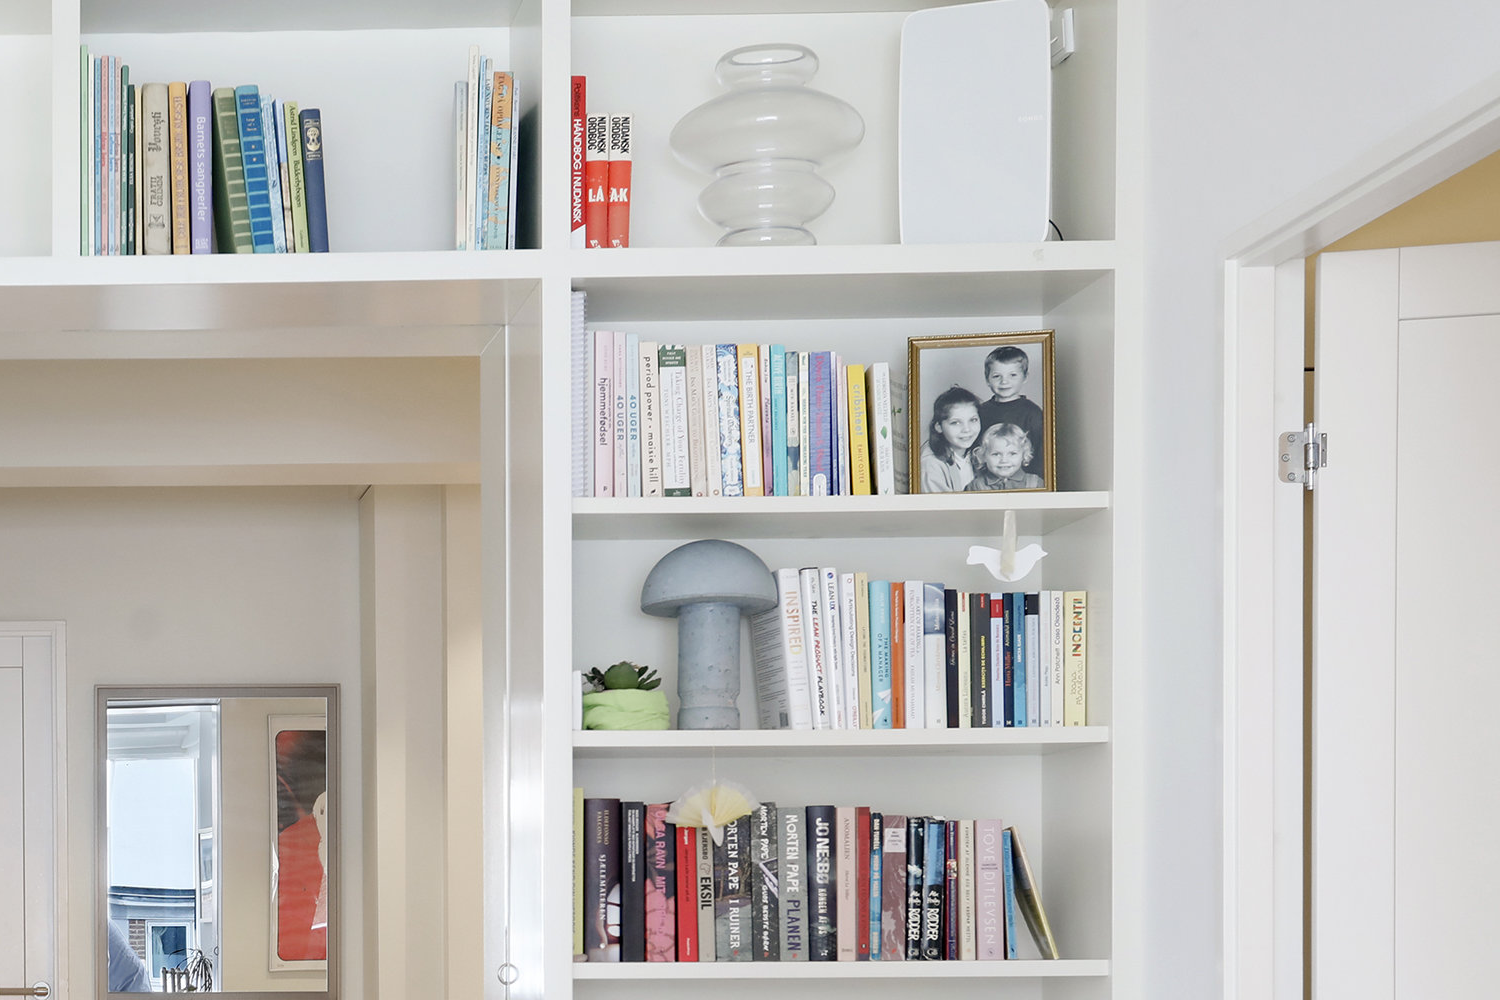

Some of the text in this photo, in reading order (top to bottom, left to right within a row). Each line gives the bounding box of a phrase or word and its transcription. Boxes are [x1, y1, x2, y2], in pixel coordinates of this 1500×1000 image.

[289, 105, 297, 125] Astrid
[290, 127, 299, 156] Lindgren
[573, 119, 584, 169] HÅNDBOG
[588, 117, 597, 150] ORDBOG
[597, 116, 607, 154] NUDANSK
[611, 117, 621, 150] ORDBOG
[620, 116, 630, 154] NUDANSK
[195, 116, 207, 221] Barnets sangperler
[573, 176, 582, 222] NUDANSK
[643, 356, 655, 388] period
[597, 378, 608, 445] hjemmefødsel
[617, 395, 624, 409] 40
[630, 395, 637, 409] 40
[644, 391, 653, 421] power
[746, 387, 754, 409] BIRTH
[853, 384, 865, 436] cribsheet
[674, 369, 687, 485] Taking Charge of Your Fertility
[649, 467, 659, 482] hill
[827, 582, 836, 600] LEAN
[828, 601, 836, 611] UX
[785, 591, 804, 655] INSPIRED
[812, 617, 820, 637] LEAN
[847, 598, 856, 630] Articulating
[814, 640, 822, 673] PRODUCT
[848, 631, 857, 650] Design
[817, 676, 825, 716] PLAYBOOK
[759, 804, 768, 859] MORTEN PAPE
[843, 818, 851, 860] ANOMALIEN
[655, 841, 666, 869] RAVN
[728, 820, 739, 890] ORTEN PAPE
[786, 814, 799, 892] MORTEN PAPE
[599, 854, 607, 921] SJÆLEMALEREN
[655, 876, 666, 894] MIT
[700, 876, 712, 910] EKSIL
[818, 889, 828, 914] KONGEN
[983, 826, 996, 944] TOVE DITLEVSEN
[729, 907, 740, 948] RUINER
[787, 899, 801, 951] PLANEN
[818, 916, 827, 924] AF
[908, 907, 921, 940] RØDDER
[927, 907, 940, 940] RØDDER
